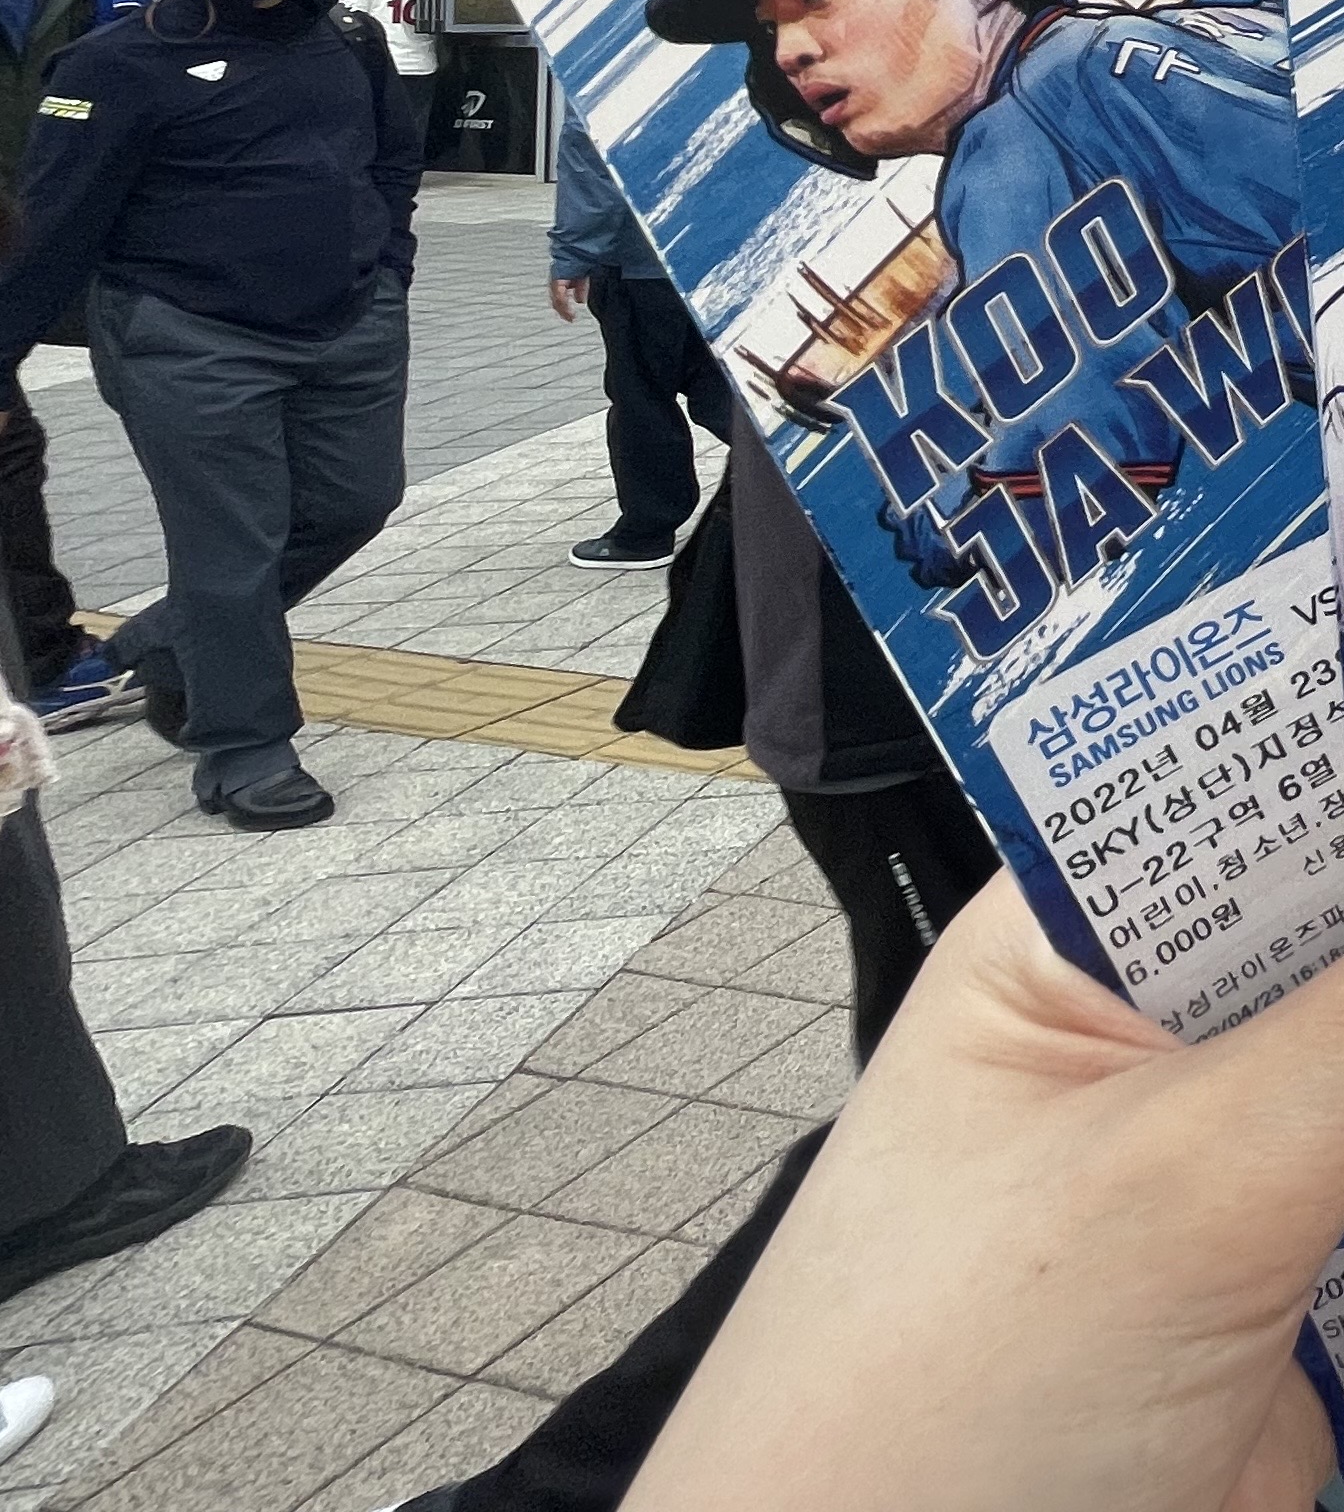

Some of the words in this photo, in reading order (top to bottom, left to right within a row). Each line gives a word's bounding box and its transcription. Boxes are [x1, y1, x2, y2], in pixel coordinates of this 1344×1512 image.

[832, 178, 1175, 514] KOO
[925, 420, 1158, 666] JA
[1026, 600, 1272, 760] 삼성라이온즈
[1290, 585, 1339, 626] VS
[1044, 743, 1184, 844] 2022년
[1194, 690, 1278, 752] 04월
[1290, 649, 1343, 700] 23
[1048, 691, 1200, 788] SAMSUNG
[1202, 642, 1286, 699] LIONS
[1278, 752, 1337, 803] 6열
[1125, 896, 1243, 987] 6.000원
